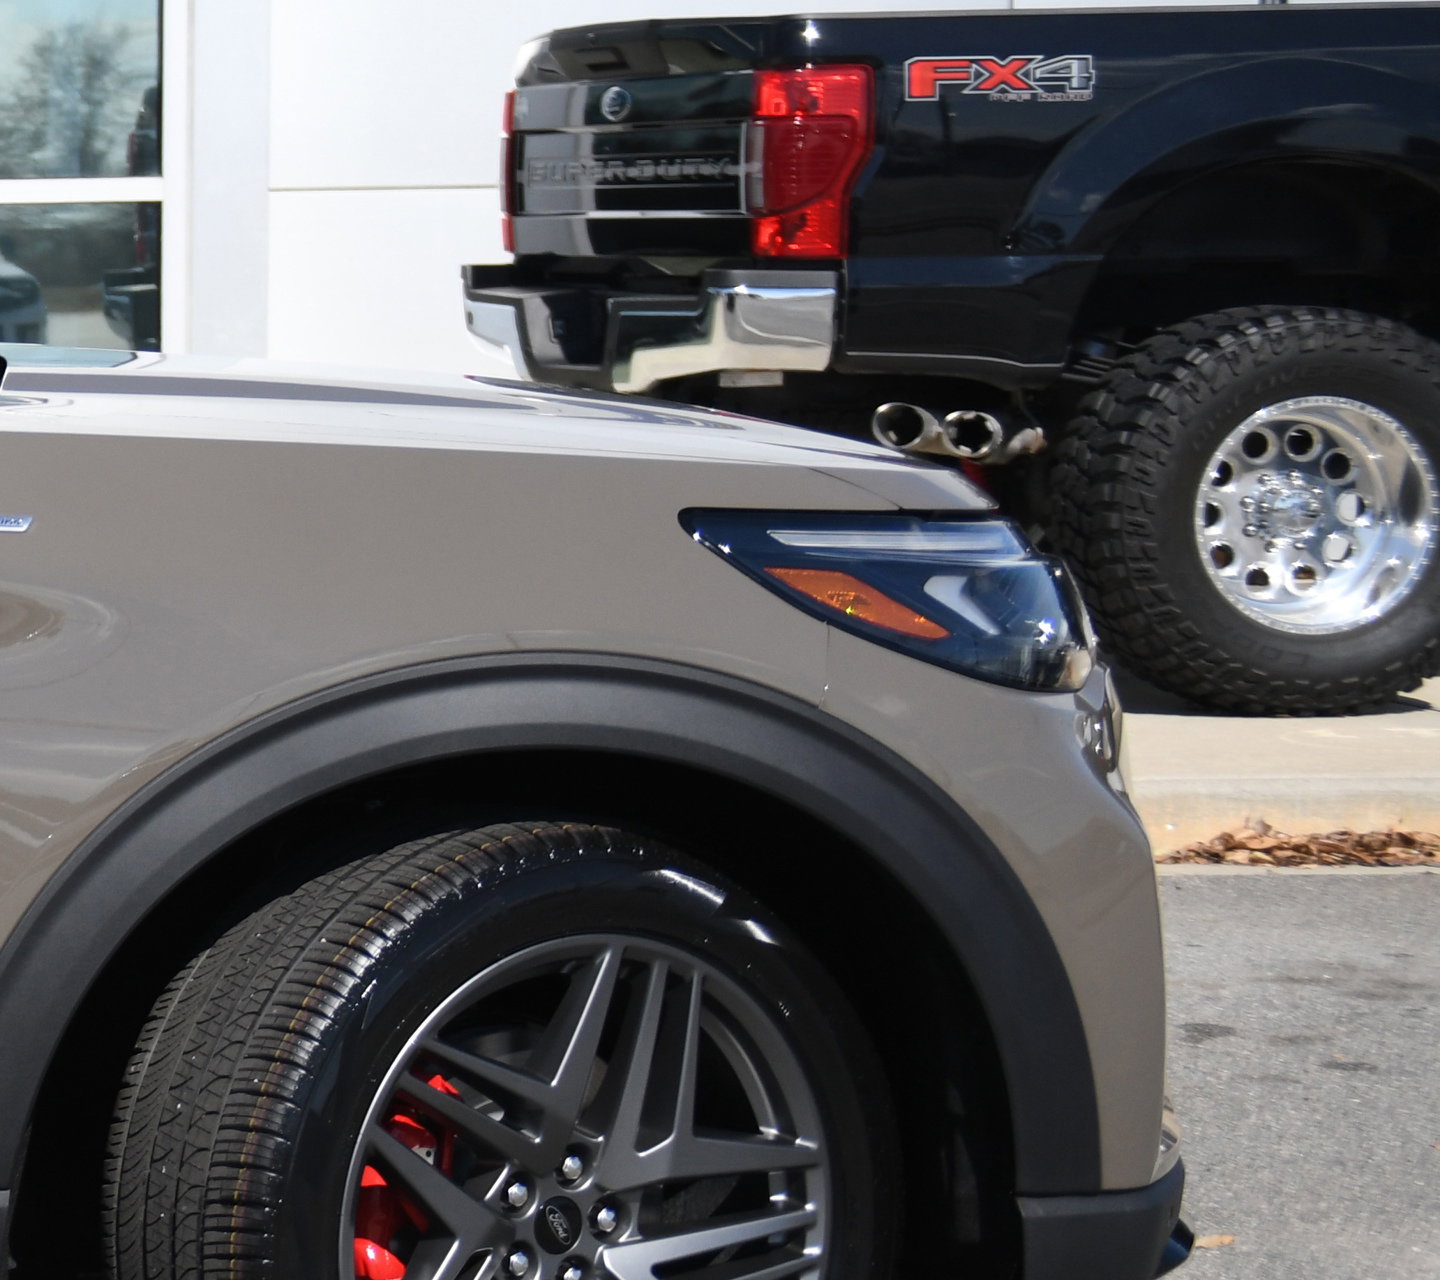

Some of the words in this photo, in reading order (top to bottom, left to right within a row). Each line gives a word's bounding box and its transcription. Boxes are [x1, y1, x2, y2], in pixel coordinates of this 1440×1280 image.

[904, 55, 1095, 102] FX4
[529, 157, 628, 182] SUPER
[635, 156, 731, 181] DUTY
[547, 1210, 570, 1241] Ford
